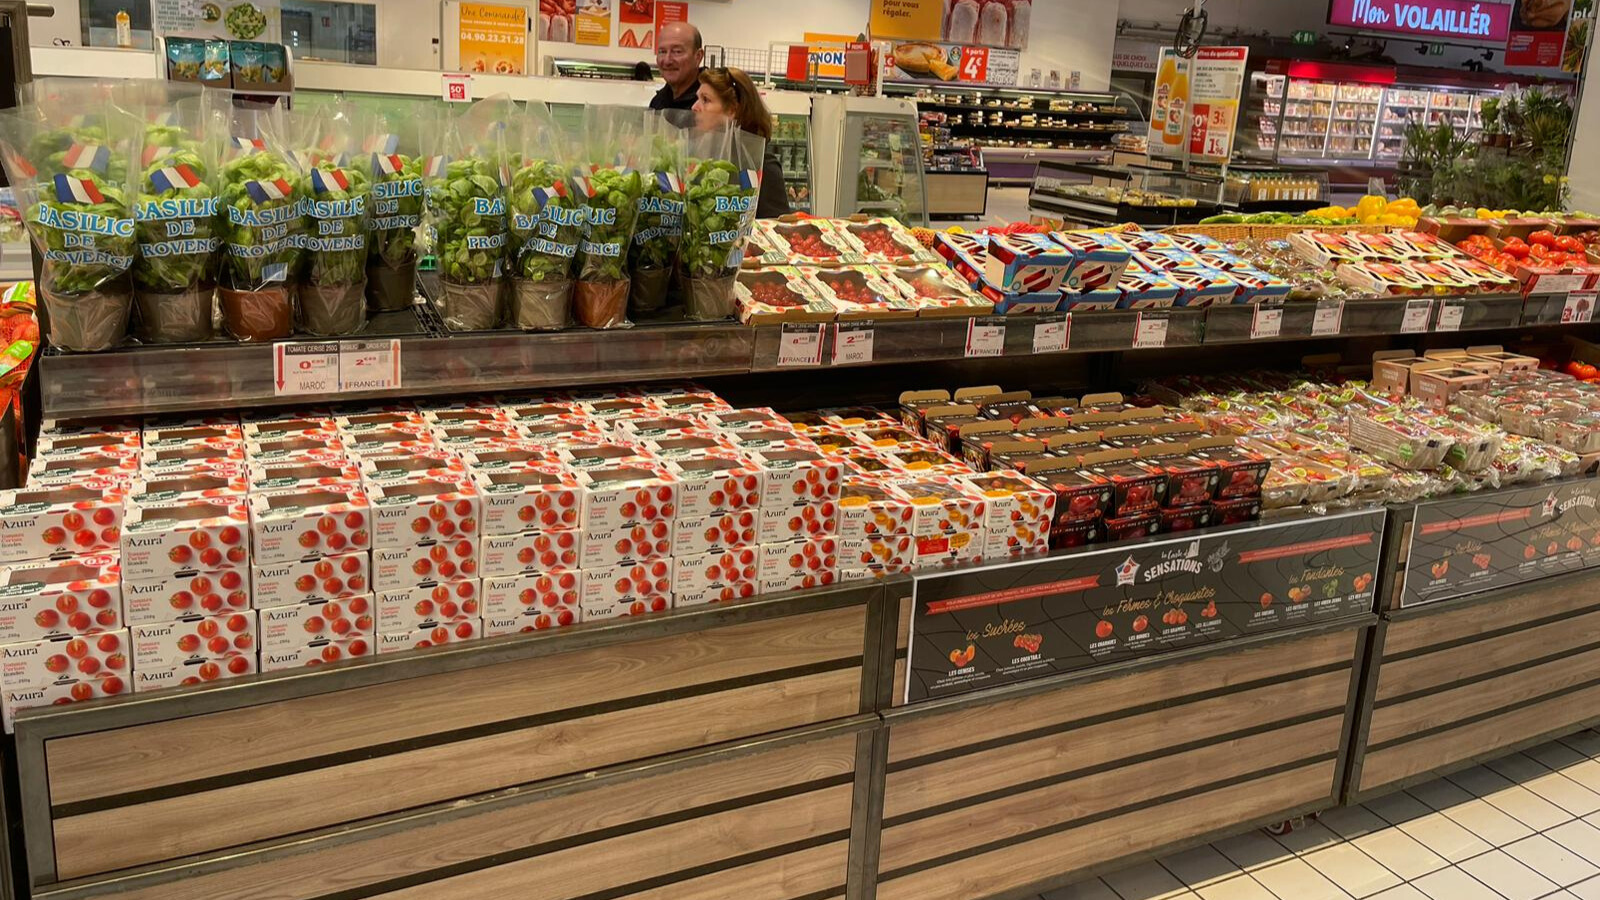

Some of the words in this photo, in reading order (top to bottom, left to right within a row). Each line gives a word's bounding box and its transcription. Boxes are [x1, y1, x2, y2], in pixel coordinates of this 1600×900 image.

[883, 8, 912, 18] régaler.
[1352, 0, 1389, 25] Mon
[303, 196, 365, 218] ASILIC
[376, 200, 398, 215] DE
[39, 202, 135, 237] BASILIC
[166, 219, 196, 237] DE
[262, 222, 288, 241] DE
[318, 220, 344, 235] DE
[539, 222, 558, 239] DE
[64, 232, 96, 248] DE
[846, 352, 864, 360] MAROC
[976, 347, 996, 355] FRANCE
[300, 381, 326, 391] MAROC
[349, 380, 381, 389] FRANCE
[769, 472, 791, 481] Azura
[683, 483, 707, 492] Azura
[488, 497, 515, 507] Azura
[592, 494, 617, 504] Azura
[377, 508, 407, 519] Azura
[765, 509, 786, 518] Azura
[1, 518, 36, 530] Azura
[262, 522, 294, 534] Azura
[679, 520, 702, 530] Azura
[587, 531, 612, 541] Azura
[129, 537, 163, 548] Azura
[488, 539, 514, 549] Azura
[379, 550, 408, 561] Azura
[766, 547, 788, 556] Azura
[680, 559, 703, 567] Azura
[258, 567, 290, 580] Azura
[587, 571, 612, 581] Azura
[1144, 558, 1203, 582] SENSATIONS
[1300, 563, 1345, 583] Fondantes
[130, 582, 164, 595] Azura
[489, 580, 516, 590] Azura
[766, 580, 787, 589] Azura
[381, 592, 410, 604] Azura
[681, 593, 704, 602] Azura
[1103, 605, 1114, 616] les
[1117, 598, 1152, 614] Fermes
[1164, 586, 1216, 608] Croquantes
[267, 610, 299, 622] Azura
[587, 607, 612, 617] Azura
[489, 618, 516, 628] Azura
[137, 627, 172, 639] Azura
[966, 629, 981, 641] les
[981, 619, 1026, 638] Sucrées
[381, 633, 410, 645] Azura
[4, 646, 39, 658] Azura
[268, 653, 299, 665] Azura
[141, 669, 174, 681] Azura
[10, 690, 45, 703] Azura
